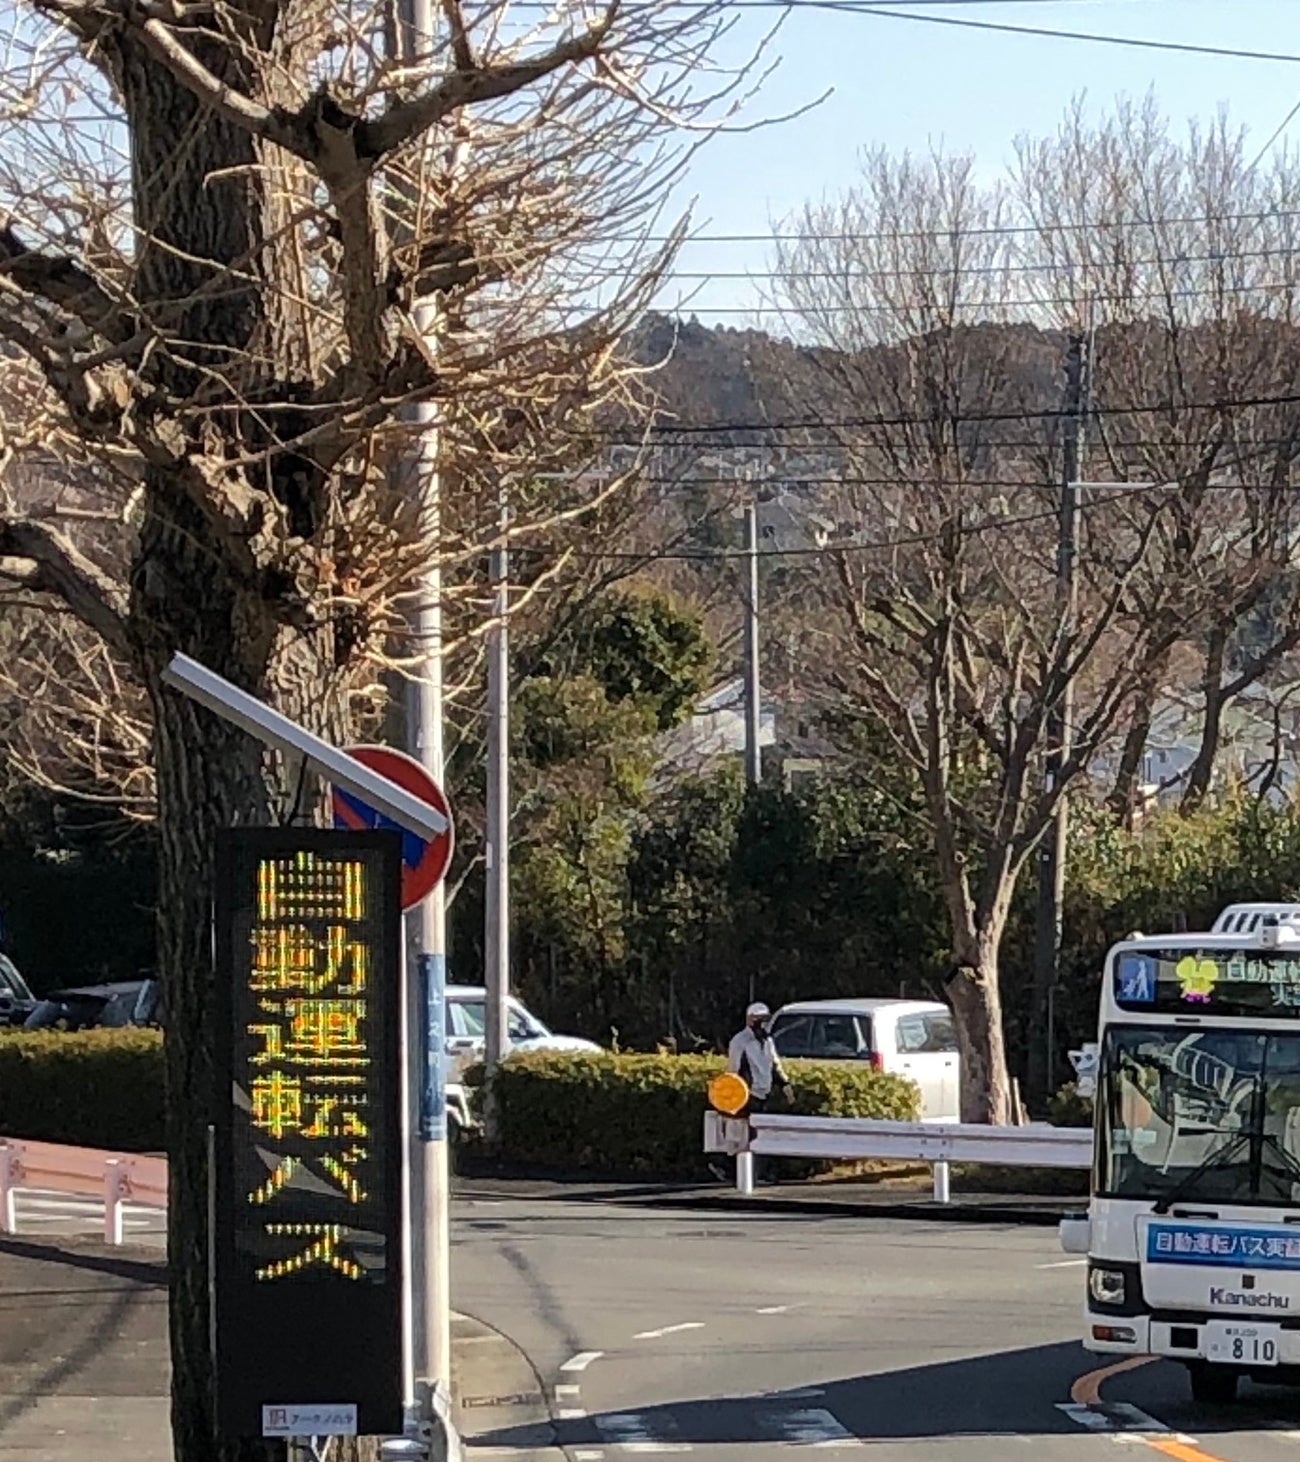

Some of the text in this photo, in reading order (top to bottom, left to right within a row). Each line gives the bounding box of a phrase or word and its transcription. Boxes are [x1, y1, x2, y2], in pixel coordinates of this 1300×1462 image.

[248, 851, 370, 1280] 自動運転バス
[1209, 1287, 1290, 1309] Kanachu
